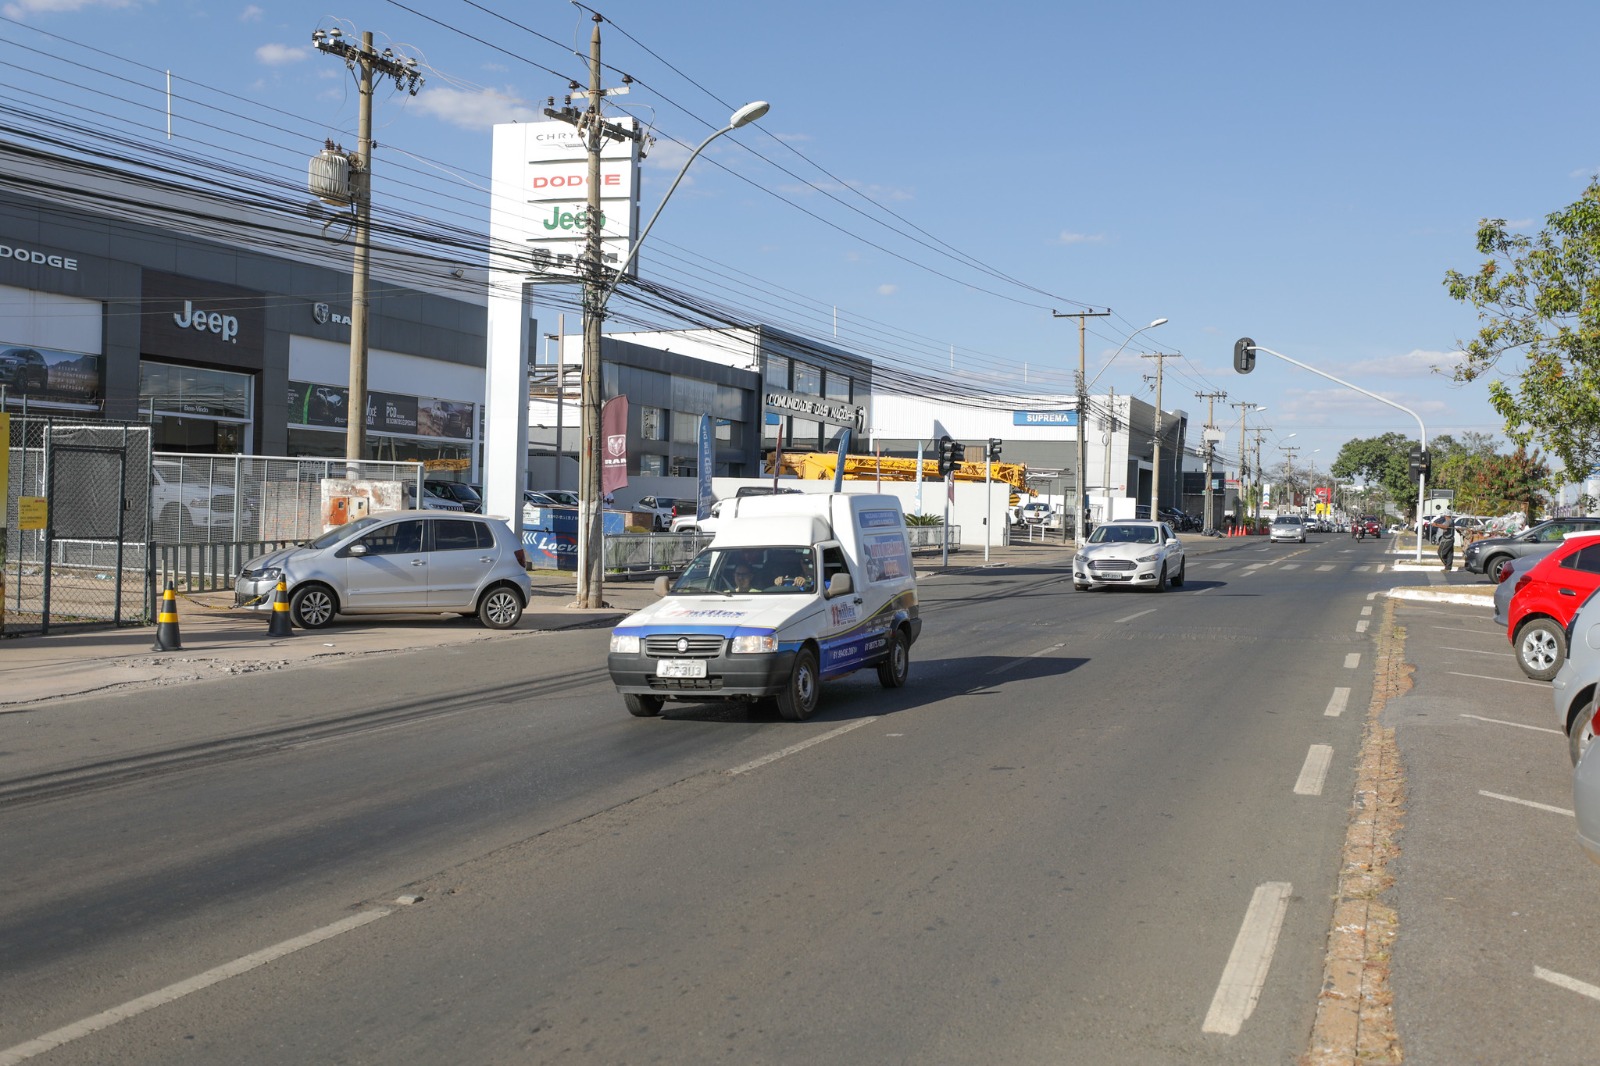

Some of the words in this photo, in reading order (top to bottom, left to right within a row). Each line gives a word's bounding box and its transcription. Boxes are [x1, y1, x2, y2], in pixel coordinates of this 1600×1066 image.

[533, 174, 621, 189] DODE
[0, 246, 77, 271] DODGE
[557, 252, 618, 264] RM
[173, 300, 239, 342] Jeep
[331, 313, 352, 325] RA
[769, 393, 813, 413] COMUNIDADE
[815, 403, 829, 417] DAS
[1027, 414, 1069, 422] SUPREMA
